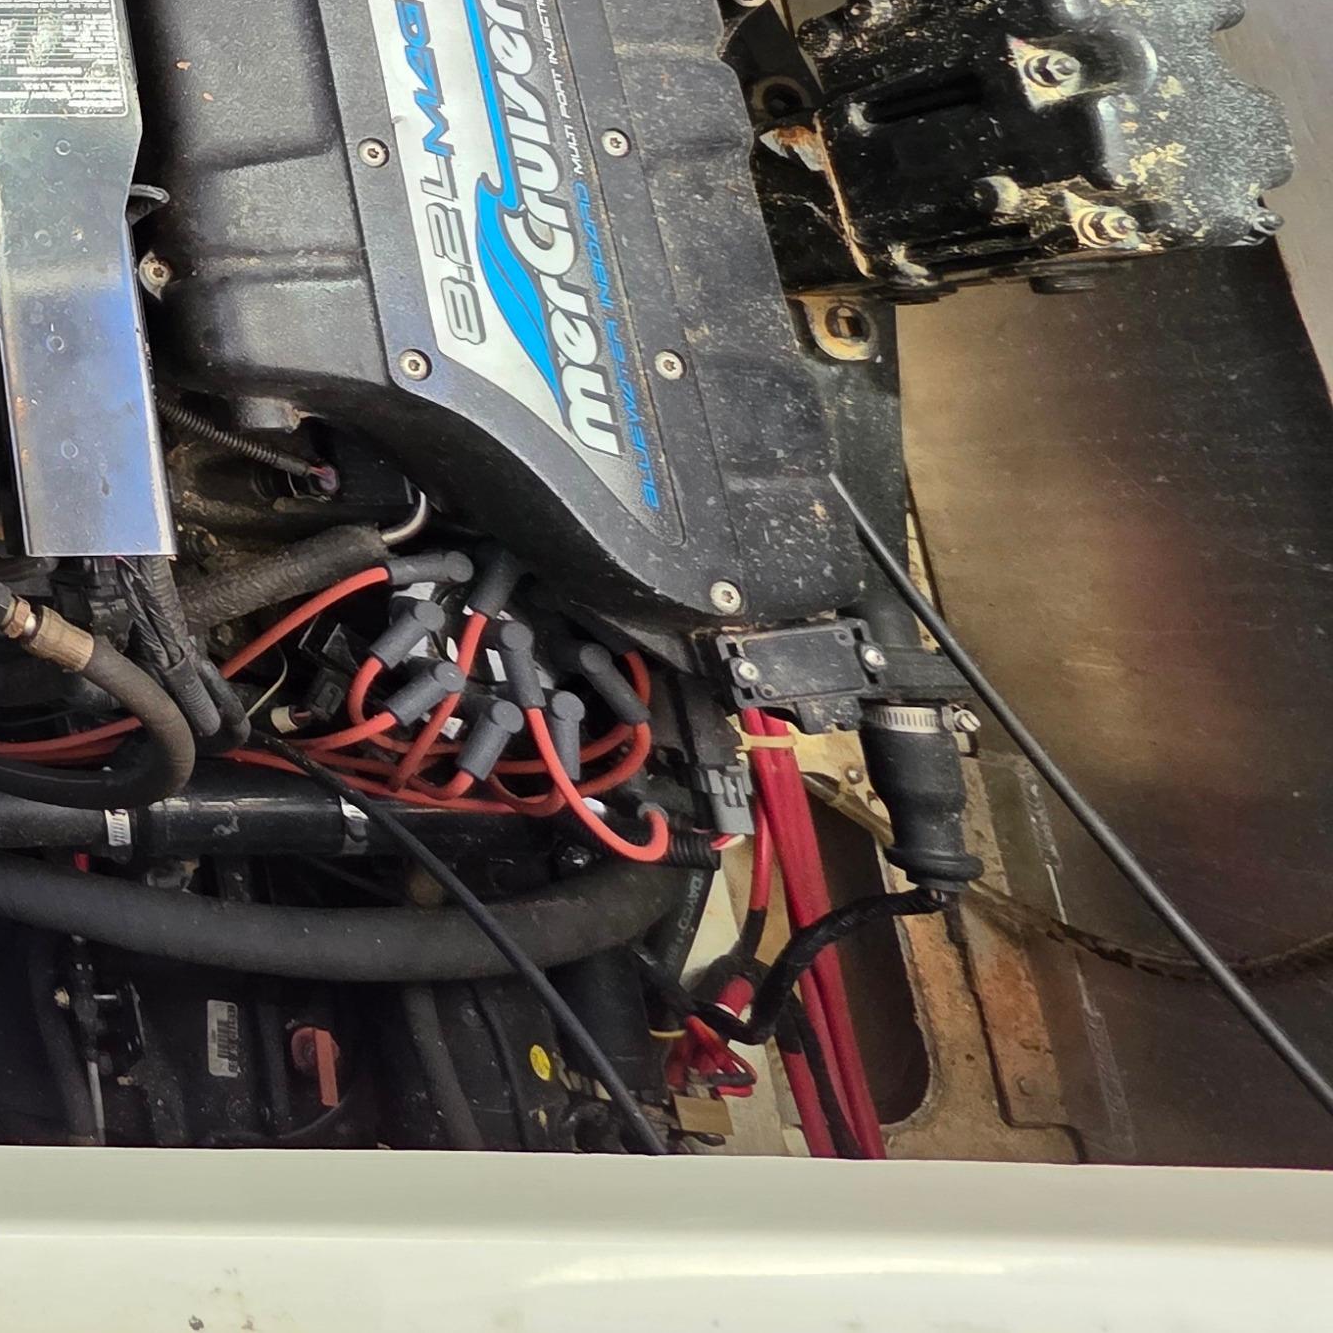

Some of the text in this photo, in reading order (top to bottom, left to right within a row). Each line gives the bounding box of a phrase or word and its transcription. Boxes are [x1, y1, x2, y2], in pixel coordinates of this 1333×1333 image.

[550, 68, 572, 119] PORT
[564, 124, 585, 176] MULTI
[573, 179, 614, 309] INBOARD
[605, 318, 660, 511] BLUEWATER
